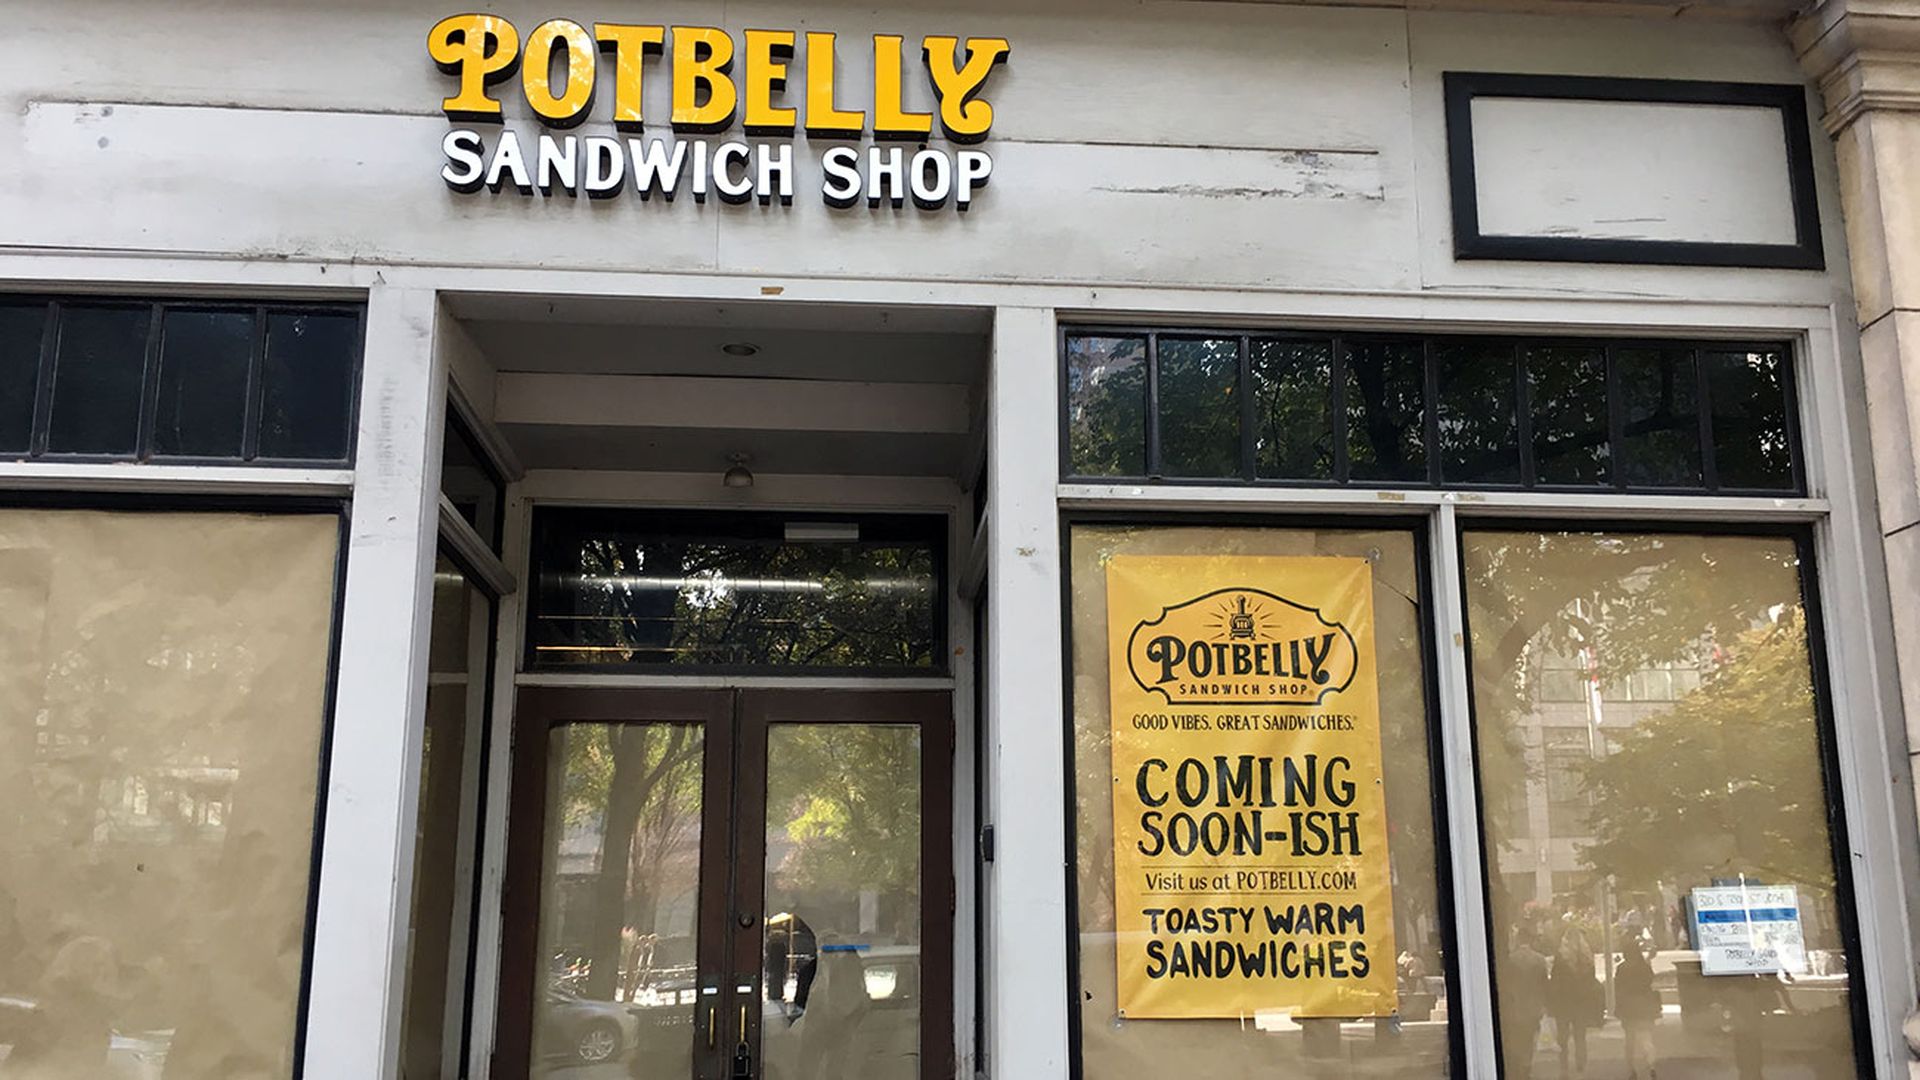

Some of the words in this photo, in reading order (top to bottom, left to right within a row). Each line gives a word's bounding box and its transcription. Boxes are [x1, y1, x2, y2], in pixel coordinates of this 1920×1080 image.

[427, 13, 1010, 144] POTBELLY
[440, 129, 795, 206] SANDWICH
[822, 146, 993, 212] SHOP
[1146, 632, 1336, 685] POTBELLY
[1179, 683, 1260, 696] SANDWICH
[1269, 684, 1308, 696] SHOP
[1132, 714, 1168, 730] GOOD
[1171, 715, 1212, 731] VIBES.
[1217, 715, 1262, 731] GREAT
[1136, 754, 1356, 808] COMING
[1137, 810, 1362, 857] SOON-ISH
[1146, 872, 1184, 891] Visit
[1189, 875, 1208, 890] us
[1212, 873, 1231, 890] at
[1237, 871, 1357, 890] POTBELLY.COM
[1142, 907, 1255, 934] TOASTY
[1264, 902, 1365, 935] WARM
[1146, 940, 1370, 979] SANDWICHES
